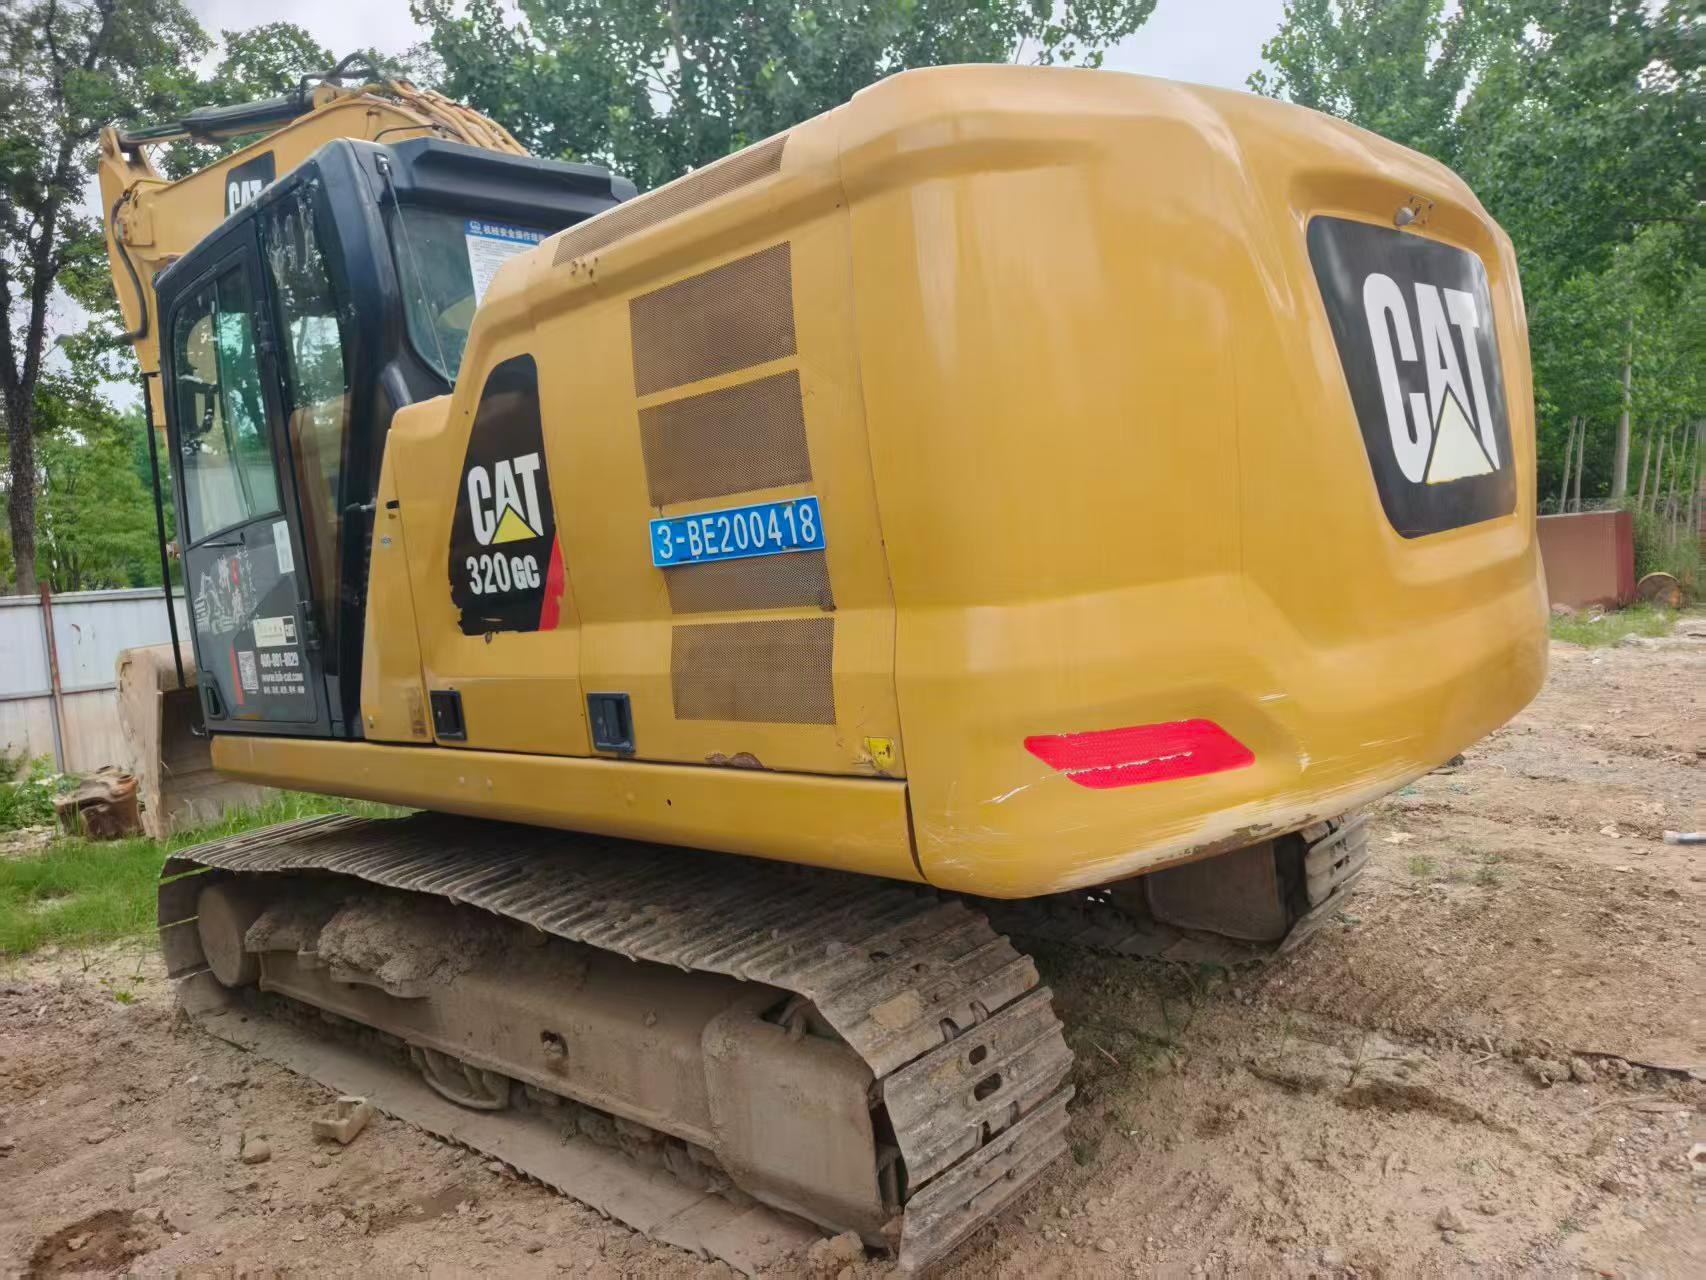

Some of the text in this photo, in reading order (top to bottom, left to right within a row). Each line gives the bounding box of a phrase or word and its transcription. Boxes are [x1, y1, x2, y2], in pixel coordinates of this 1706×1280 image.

[1363, 273, 1500, 483] CAT
[467, 452, 544, 546] CAT
[657, 503, 816, 559] 3-BE200418
